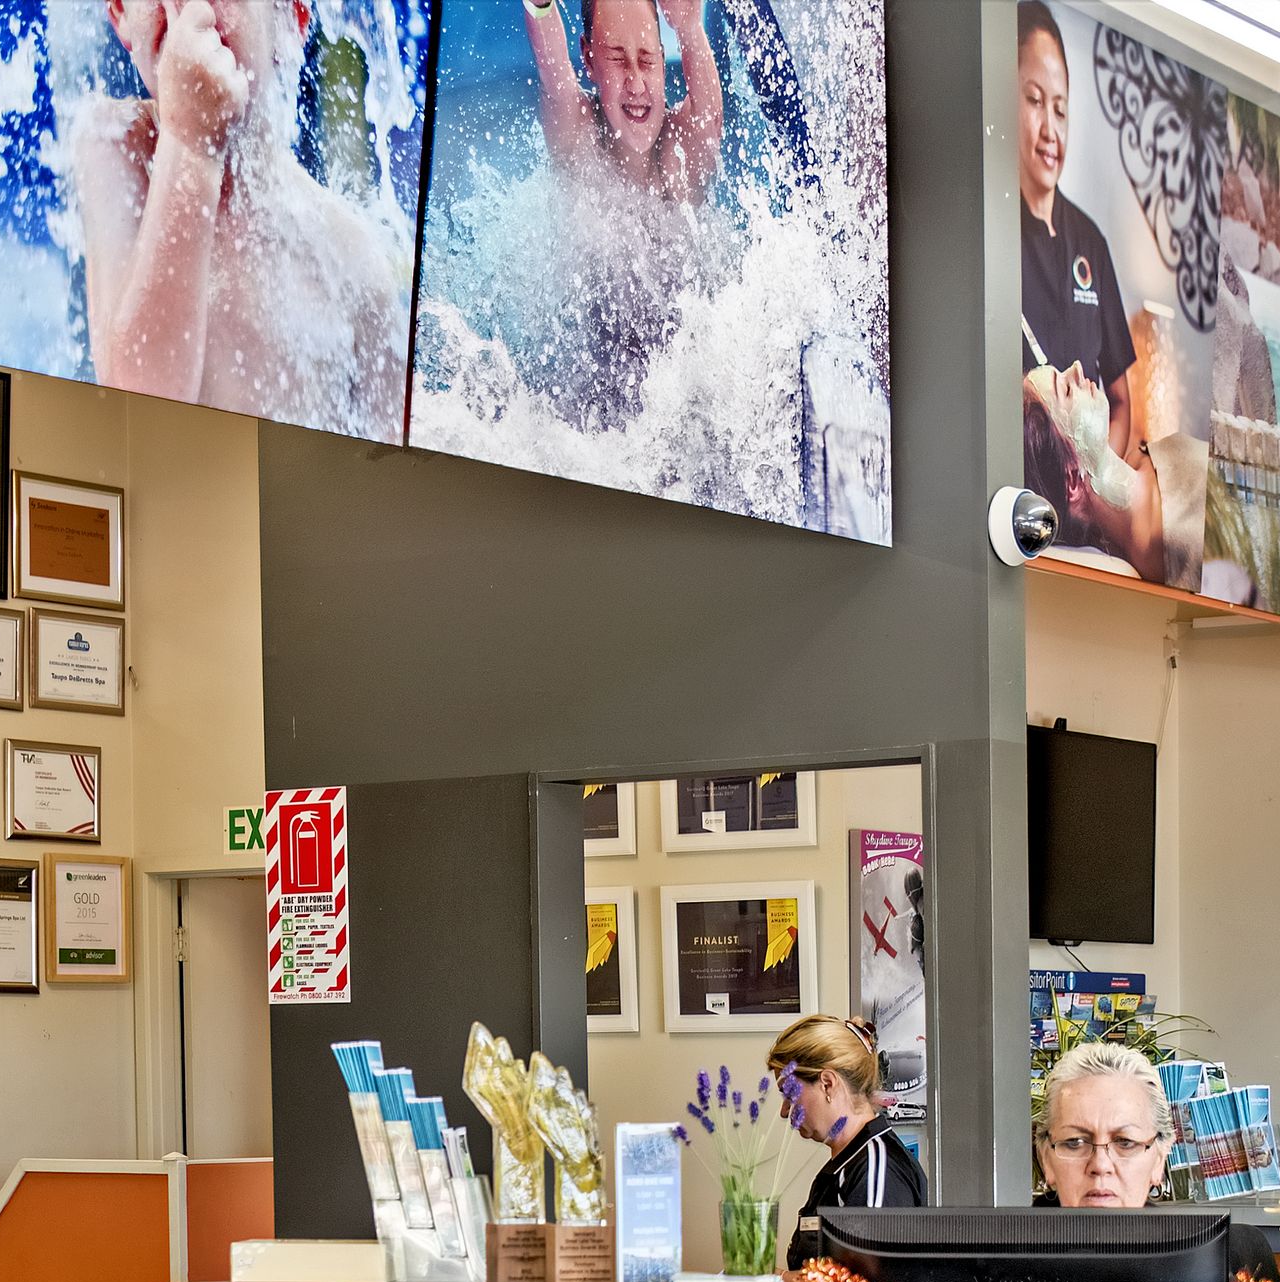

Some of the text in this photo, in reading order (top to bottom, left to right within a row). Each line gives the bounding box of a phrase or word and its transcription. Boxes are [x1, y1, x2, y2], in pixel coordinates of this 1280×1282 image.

[51, 672, 67, 681] Taupo
[94, 678, 106, 686] Spa
[228, 808, 265, 850] EX
[73, 892, 100, 905] GOLD
[297, 896, 308, 904] DRY
[309, 895, 333, 903] POWDER
[76, 907, 97, 918] 2015
[282, 904, 333, 913] FIRE EXTINGUISHER
[693, 935, 740, 945] FINALIST
[1030, 971, 1065, 989] sitorPoint
[273, 992, 300, 1000] Firewatch
